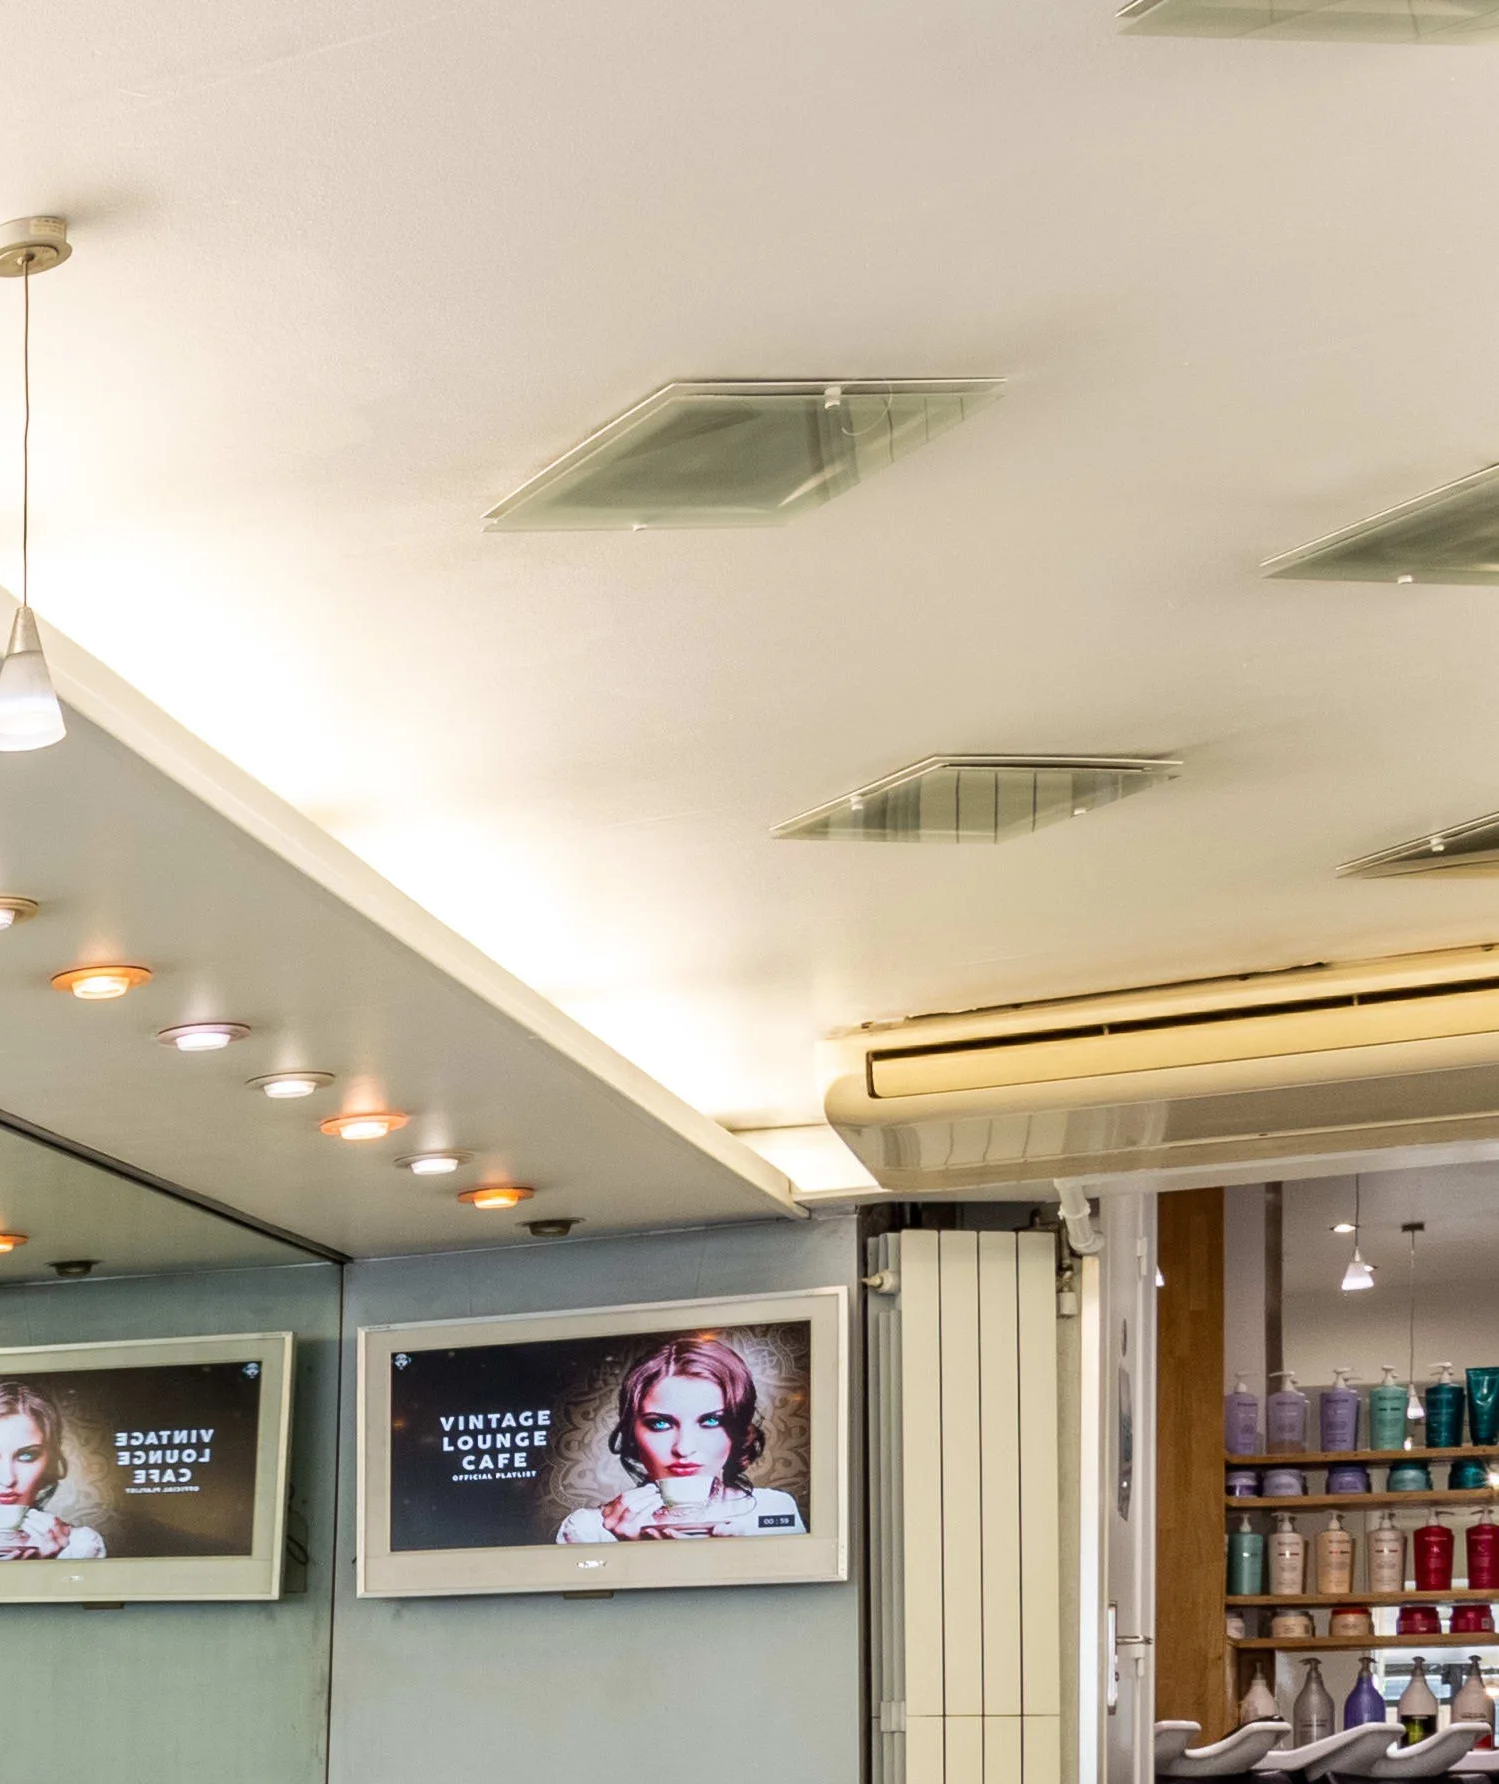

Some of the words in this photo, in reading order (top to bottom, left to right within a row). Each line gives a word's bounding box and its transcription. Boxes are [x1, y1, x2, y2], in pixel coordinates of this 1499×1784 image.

[440, 1410, 551, 1431] VINTAGE
[442, 1431, 547, 1452] LOUNGE
[462, 1452, 527, 1471] CAFE
[452, 1473, 493, 1482] OFFICIAL
[495, 1470, 537, 1479] PLAYLIST
